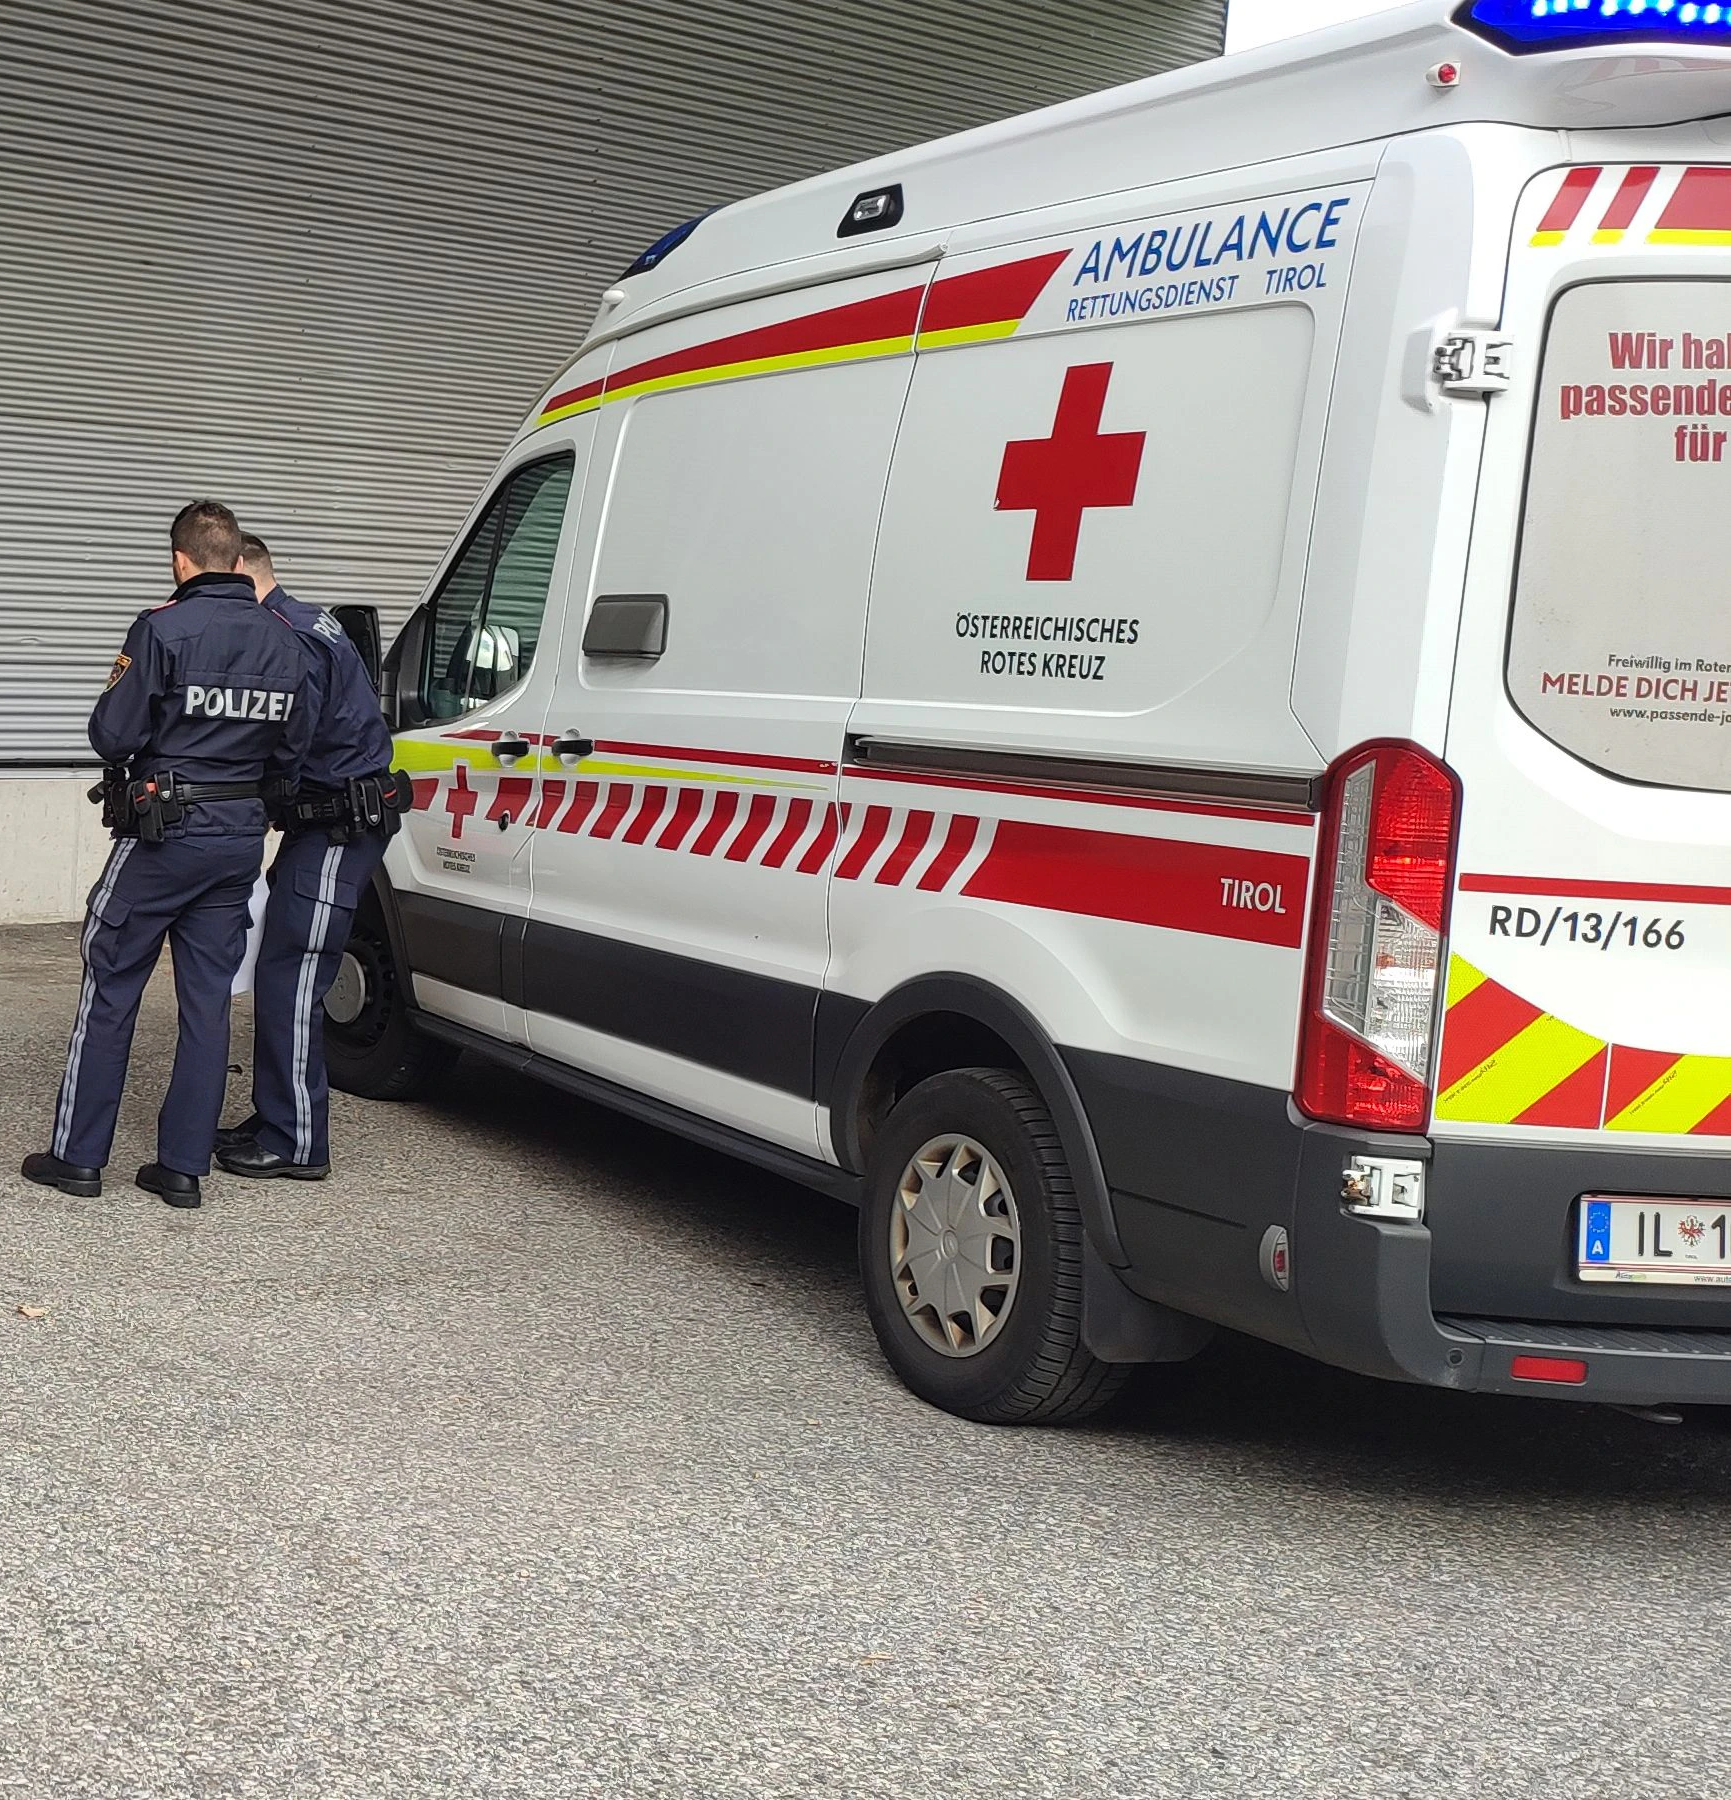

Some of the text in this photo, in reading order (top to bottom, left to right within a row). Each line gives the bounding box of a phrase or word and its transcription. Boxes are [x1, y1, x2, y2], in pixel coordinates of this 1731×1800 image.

[1073, 197, 1351, 287] AMBULANCE
[1066, 262, 1327, 322] RETTUNGSDIENST TIROL
[1609, 332, 1731, 370] Wir ha
[1560, 378, 1731, 420] passende
[1674, 423, 1728, 462] für
[955, 612, 1140, 645] ÖSTERREICHISCHES
[980, 650, 1107, 681] ROTES KREUZ
[1607, 654, 1671, 673] Freiwillig
[1675, 657, 1692, 671] im
[185, 685, 295, 722] POLIZEI
[1541, 671, 1731, 703] MELDE DICH JE
[1220, 877, 1287, 914] TIROL
[1489, 904, 1685, 951] RD/13/166
[1591, 1239, 1605, 1255] A
[1638, 1211, 1731, 1260] IL 1
